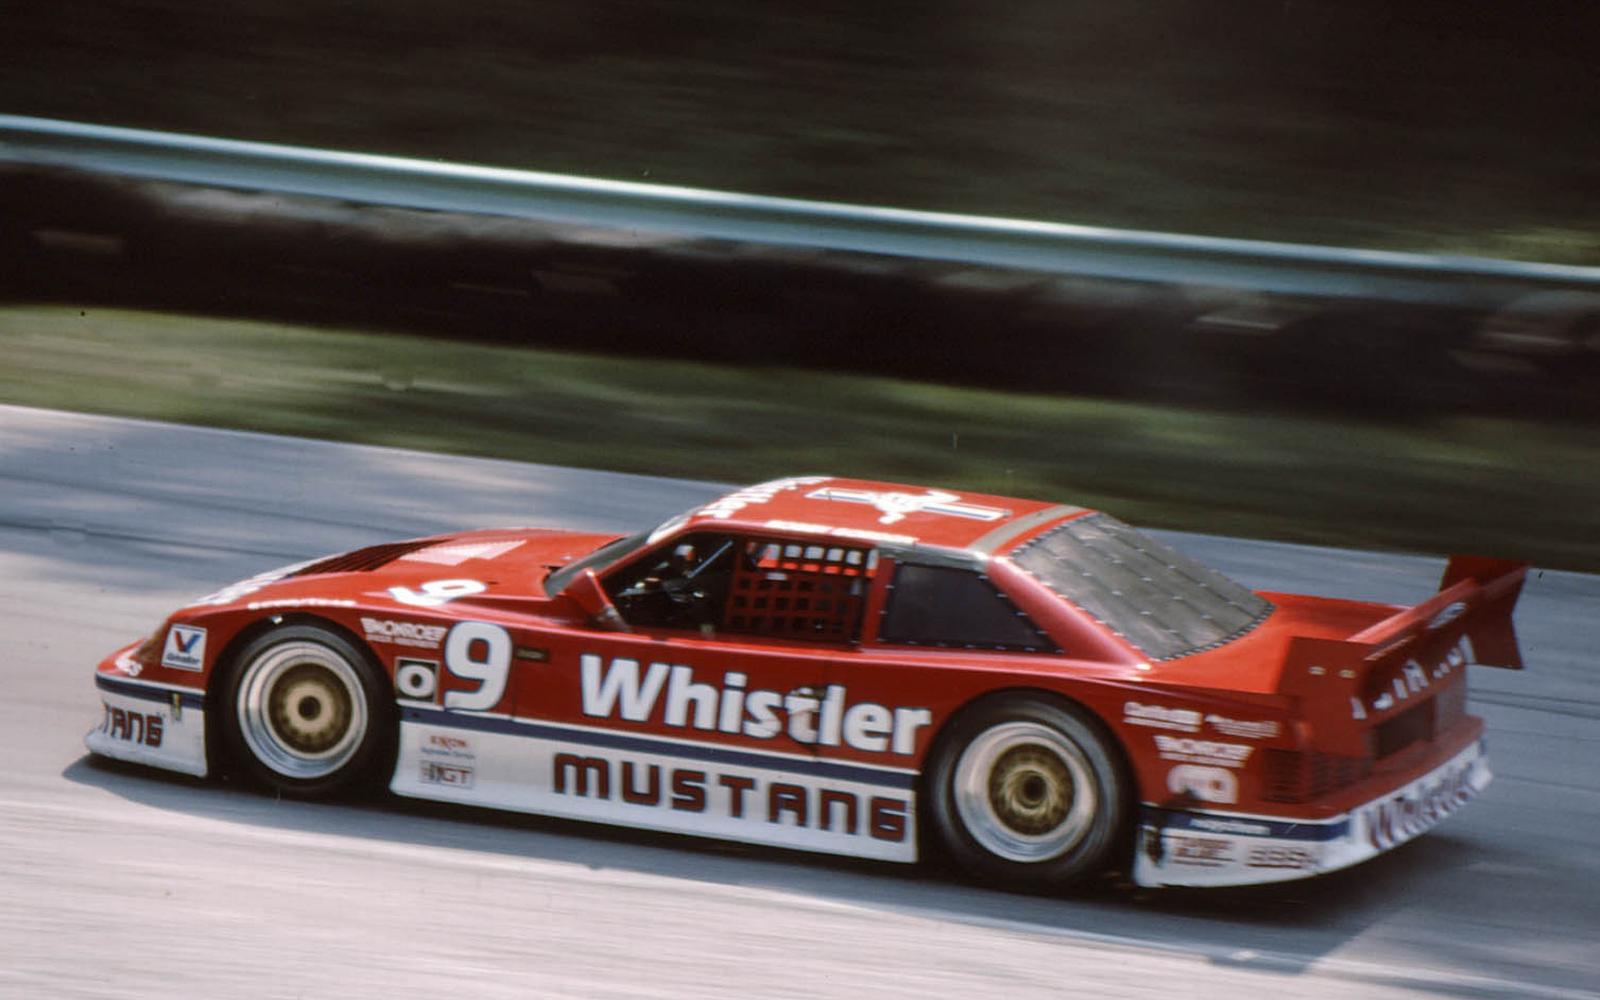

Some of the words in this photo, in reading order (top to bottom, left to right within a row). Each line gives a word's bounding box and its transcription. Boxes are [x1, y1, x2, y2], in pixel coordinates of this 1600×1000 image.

[445, 621, 512, 711] 9
[580, 654, 931, 755] Whistler
[554, 752, 909, 843] MUSTANG
